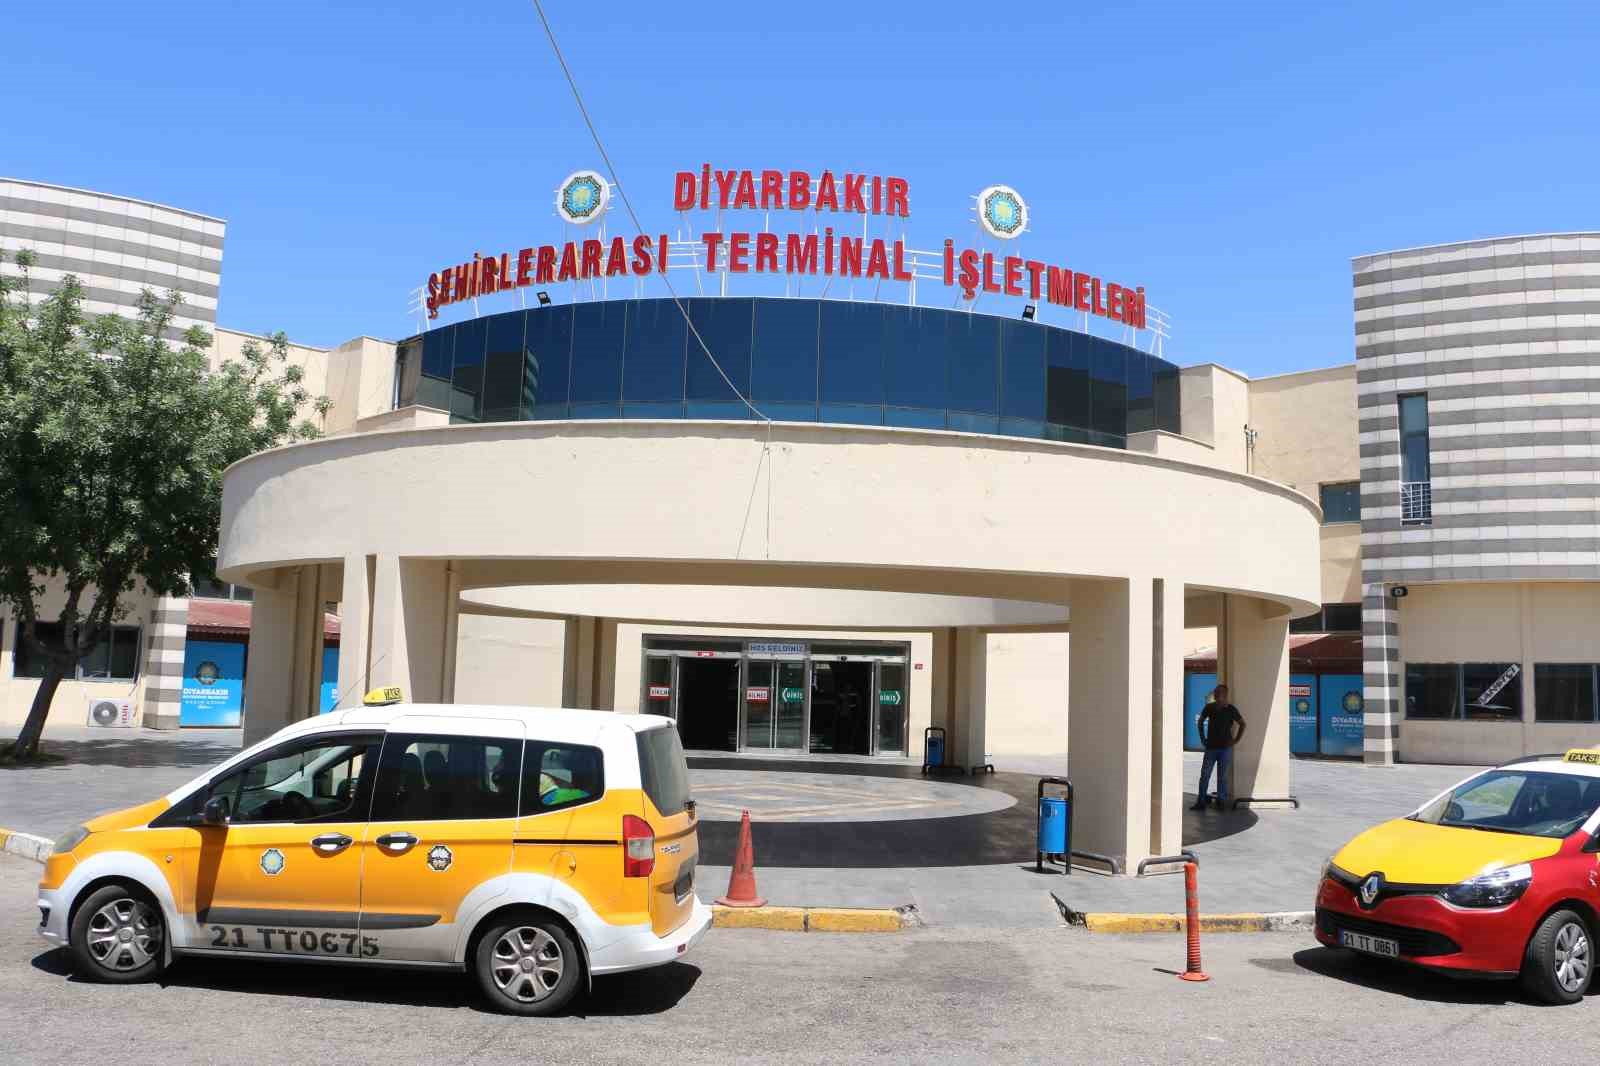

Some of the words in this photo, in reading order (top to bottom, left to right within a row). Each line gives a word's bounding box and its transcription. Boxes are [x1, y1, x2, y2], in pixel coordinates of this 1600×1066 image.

[674, 163, 910, 218] DİYARBAKIR
[427, 234, 669, 320] ŞEHİRLERARASI
[702, 227, 912, 282] TERMİNAL
[943, 238, 1147, 330] İŞLETMELERİ
[211, 926, 249, 948] 21
